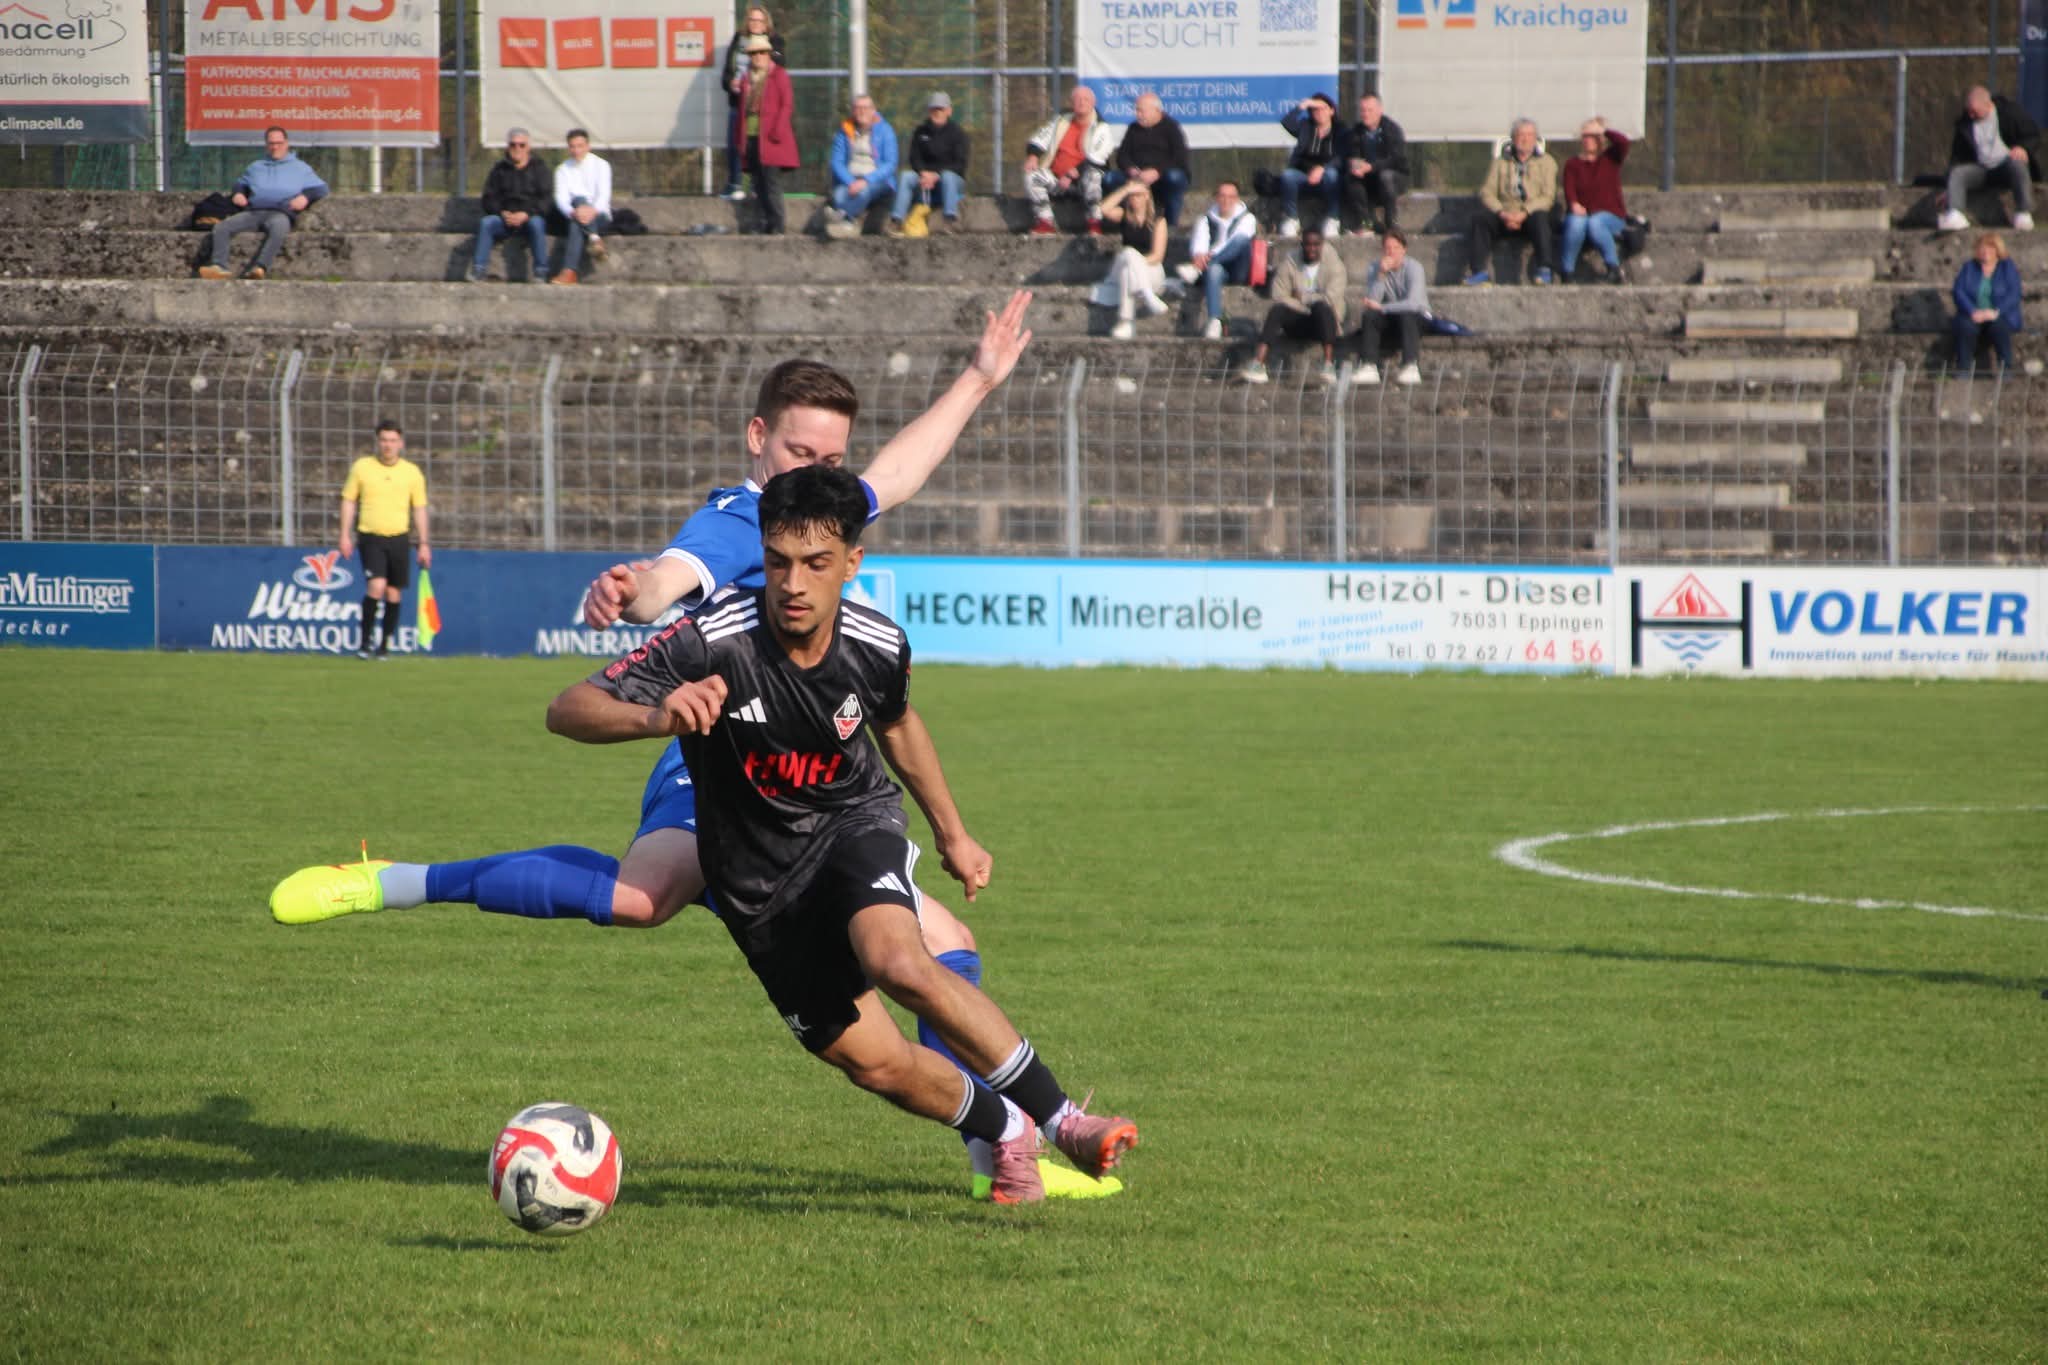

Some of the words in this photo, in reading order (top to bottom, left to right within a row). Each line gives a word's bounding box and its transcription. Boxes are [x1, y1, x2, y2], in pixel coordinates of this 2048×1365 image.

[1102, 1, 1239, 18] TEAMPLAYER
[1494, 3, 1628, 31] Kraichgau
[0, 19, 92, 39] acell
[1103, 22, 1240, 48] GESUCHT
[200, 31, 421, 47] METALLBESCHICHTUNG
[52, 73, 130, 88] ökologisch
[201, 67, 291, 79] KATHODISCHE
[296, 67, 421, 80] TAUCHLACKIERUNG
[201, 84, 350, 97] PULVERBESCHICHTUNG
[1160, 82, 1200, 97] JETZT
[1204, 81, 1248, 96] DEINE
[202, 106, 422, 122] www.ams-metallbeschichtung.de
[1200, 102, 1223, 114] BEI
[1226, 101, 1273, 114] MAPAL
[1328, 574, 1443, 600] Heizöl
[1486, 577, 1602, 605] Diesel
[906, 594, 1047, 626] HECKER
[1071, 597, 1262, 630] Mineralöle
[1769, 590, 2028, 636] VOLKER
[1450, 612, 1506, 629] 75031
[1519, 614, 1603, 632] Eppingen
[1426, 643, 1436, 659] 0
[1447, 644, 1467, 660] 72
[1477, 645, 1498, 661] 62
[1525, 639, 1556, 661] 64
[1572, 640, 1603, 662] 56
[1770, 648, 1857, 662] Innovation
[1862, 649, 1893, 662] und
[1898, 649, 1960, 663] Service
[1967, 649, 1988, 662] für
